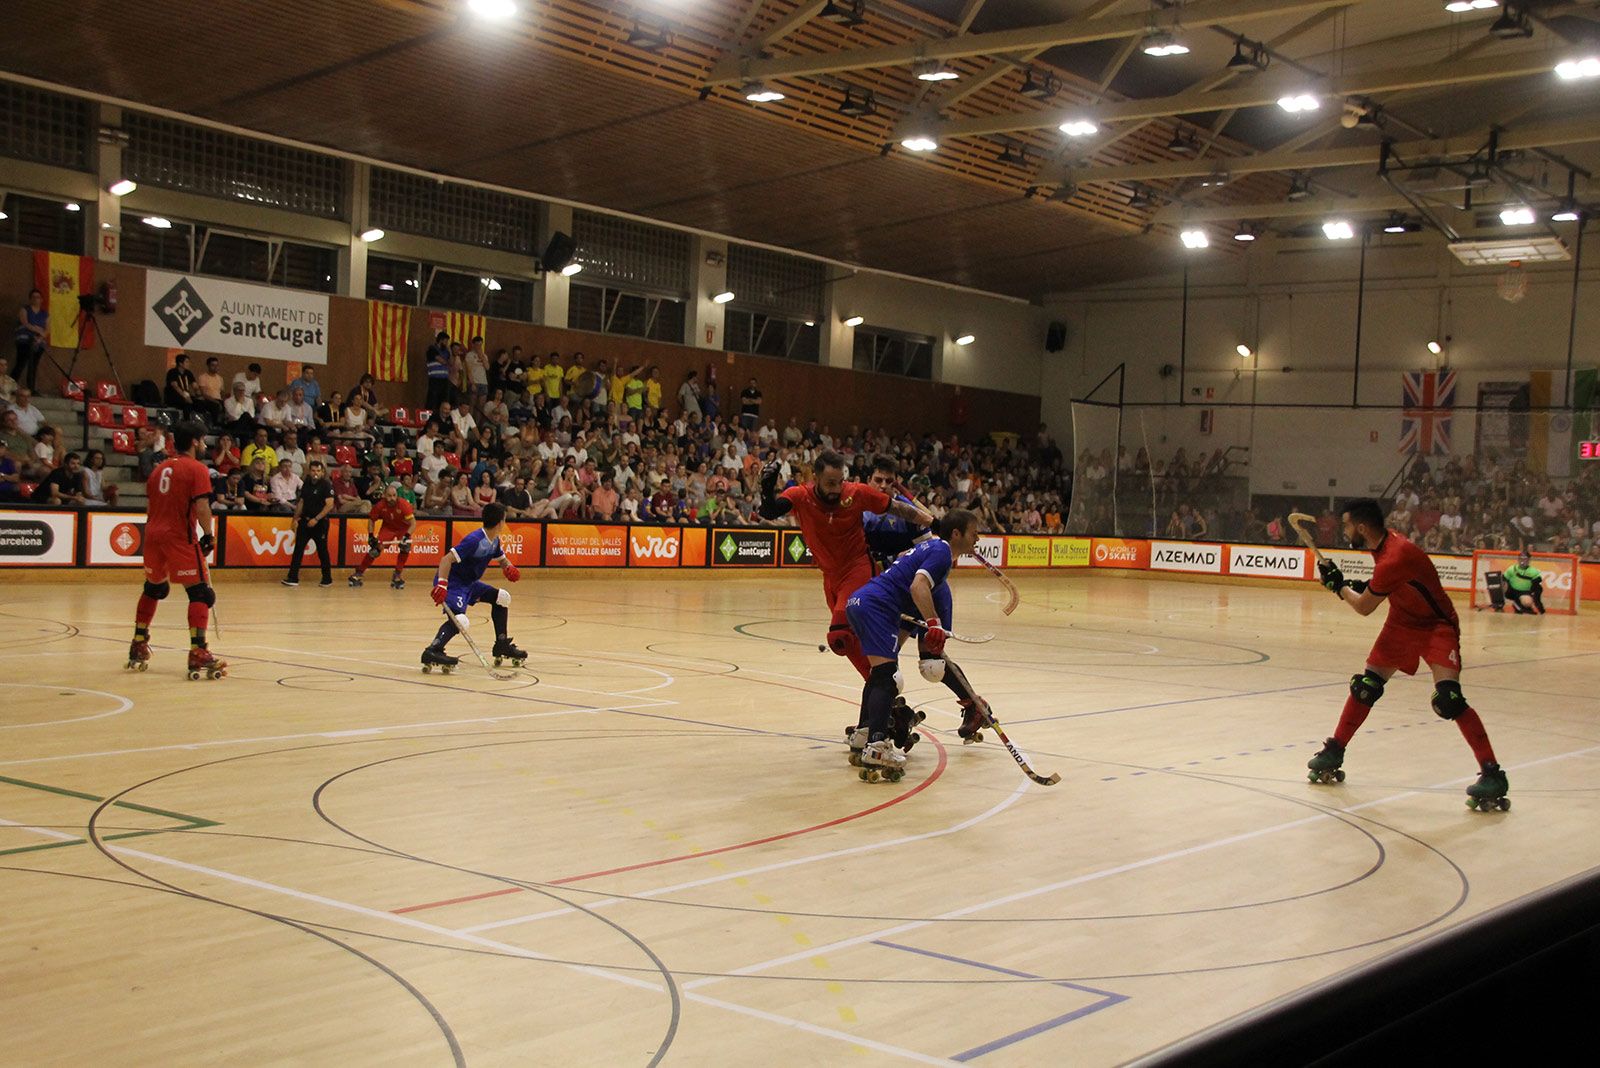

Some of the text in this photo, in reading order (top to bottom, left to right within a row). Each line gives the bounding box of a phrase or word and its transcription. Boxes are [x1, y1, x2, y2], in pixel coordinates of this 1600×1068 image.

[220, 300, 324, 326] AJUNTAMENT DE
[219, 315, 323, 348] SantCugat
[159, 467, 173, 494] 6
[0, 536, 43, 546] arcelona
[353, 533, 370, 543] SAN
[499, 534, 524, 544] ORLD
[552, 536, 568, 546] SANT
[570, 537, 588, 546] CUGAT
[413, 545, 439, 554] GAMES
[501, 544, 523, 554] ATE
[552, 547, 622, 557] WORLD ROLLER GAMES
[738, 547, 771, 558] SantCugat
[1010, 543, 1048, 555] Wall Street
[1053, 543, 1088, 555] Wall Street
[1109, 552, 1137, 561] SKATE
[1155, 550, 1216, 565] AZEMAD
[1234, 555, 1299, 570] AZEMAD
[456, 596, 464, 608] 3
[891, 633, 899, 653] 7
[1448, 649, 1457, 665] 4
[1006, 744, 1023, 763] AND
